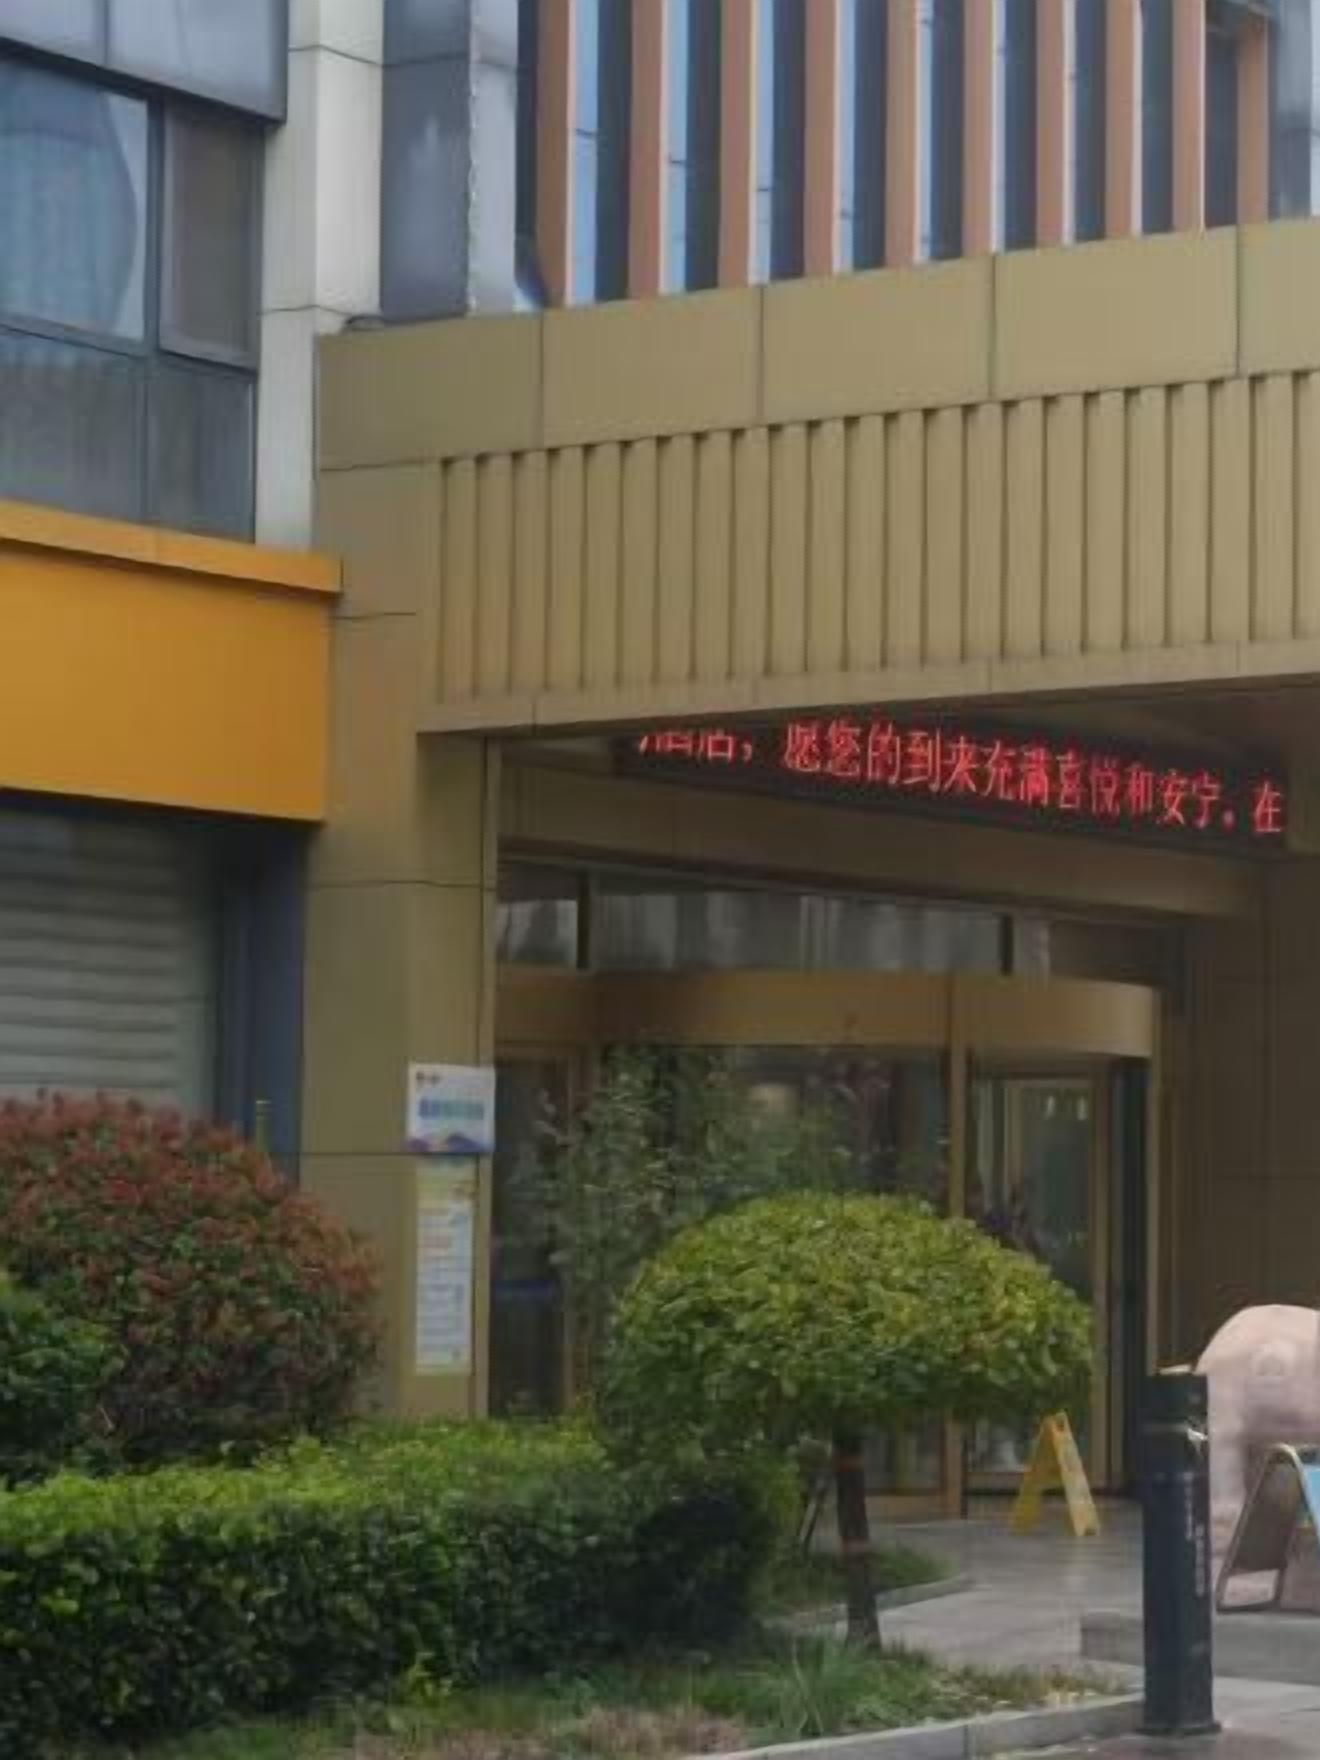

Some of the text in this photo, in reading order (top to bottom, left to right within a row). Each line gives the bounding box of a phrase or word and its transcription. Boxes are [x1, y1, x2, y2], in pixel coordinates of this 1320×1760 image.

[639, 718, 1282, 833] ，愿您的到来充满喜悦和安宁。在
